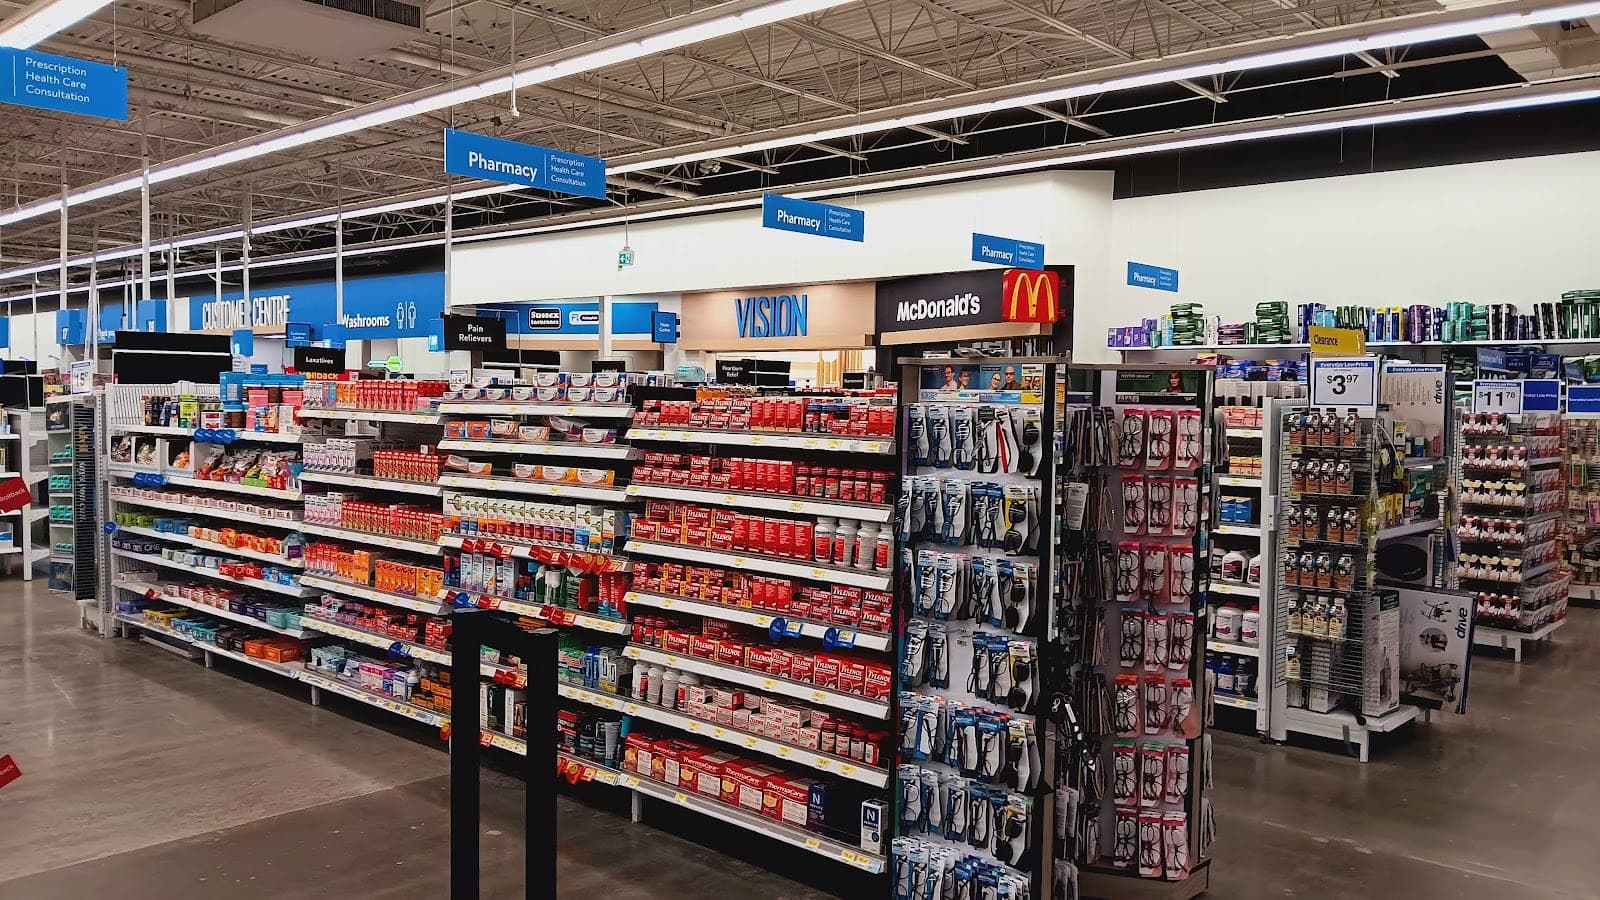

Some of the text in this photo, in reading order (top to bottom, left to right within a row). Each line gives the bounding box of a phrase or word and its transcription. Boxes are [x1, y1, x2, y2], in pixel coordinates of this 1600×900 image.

[25, 57, 87, 76] Prescription
[25, 71, 87, 89] Health Care
[25, 84, 90, 103] Consultation
[468, 151, 538, 182] Pharmacy
[551, 155, 585, 168] Prescription
[551, 165, 585, 177] Health Care
[551, 175, 587, 187] Consultation
[777, 209, 821, 231] Pharmacy
[981, 245, 1014, 263] Pharmacy
[252, 295, 291, 327] CENTRE
[897, 293, 980, 322] McDonald's
[735, 294, 807, 338] VISION
[467, 323, 484, 333] Pain
[458, 333, 492, 343] Relievers
[1314, 334, 1338, 346] Clearance
[1433, 380, 1443, 404] drive
[687, 510, 708, 518] TYLENOL
[716, 512, 735, 521] TYLENO
[636, 523, 655, 532] TYLENOL
[661, 526, 680, 534] TYLENOL
[688, 528, 706, 537] TYLENOL
[712, 531, 732, 541] TYLENOL
[832, 587, 858, 598] TYLENOL
[864, 592, 890, 602] TYLENOL
[833, 605, 857, 617] TYLENOL
[862, 611, 888, 623] TYLENOL
[1455, 607, 1468, 639] drive
[668, 634, 688, 644] TYLENOL
[694, 640, 715, 651] TYLENOL
[720, 645, 740, 656] TYLENOL
[816, 661, 837, 670] TYLENOL
[841, 665, 862, 676] TYLENOL
[868, 671, 890, 682] TYLENOL
[683, 757, 718, 771] ThermaCare
[725, 767, 760, 784] ThermaCare
[767, 781, 804, 798] ThermaCare
[812, 792, 820, 805] N
[866, 809, 876, 821] N
